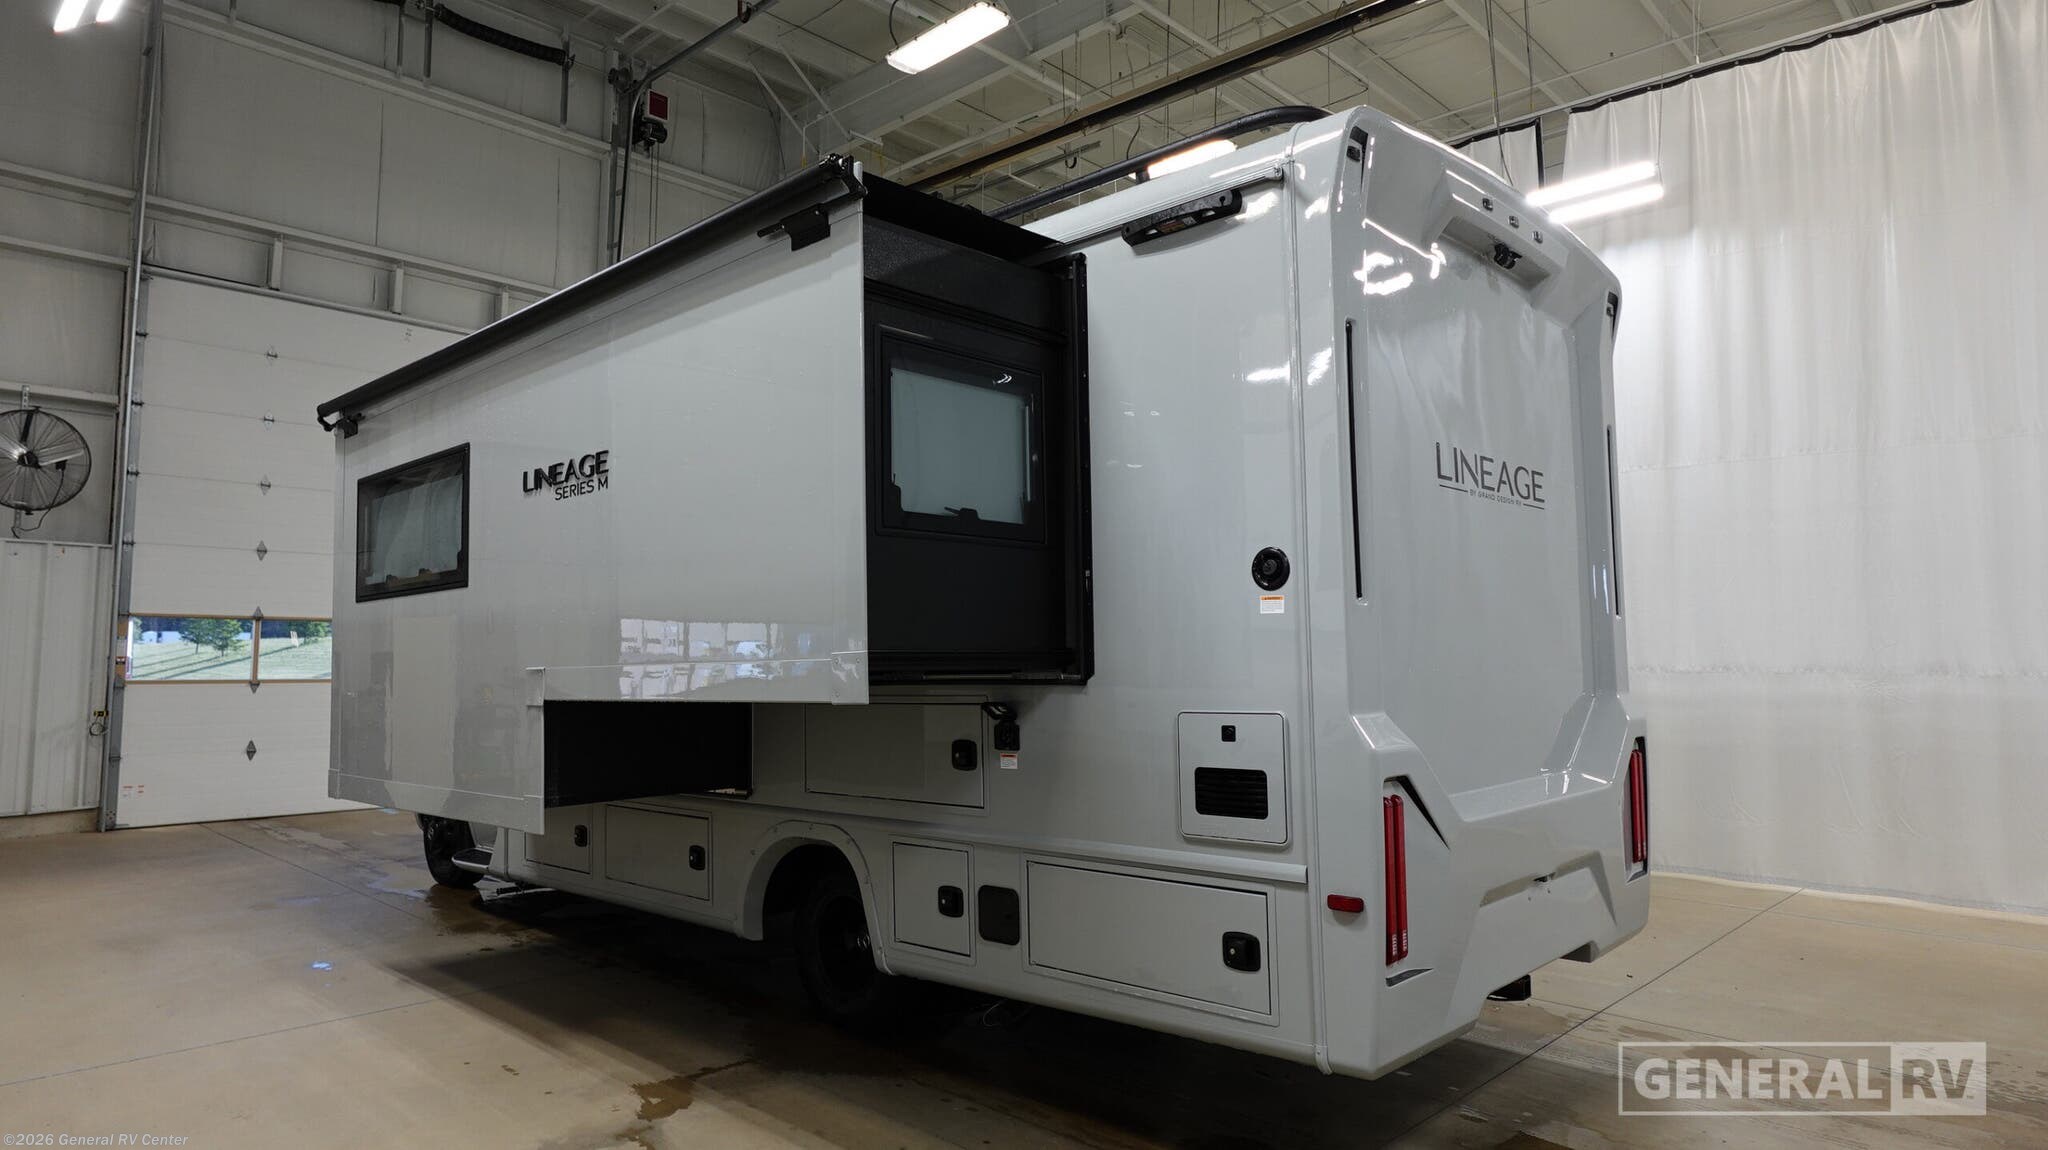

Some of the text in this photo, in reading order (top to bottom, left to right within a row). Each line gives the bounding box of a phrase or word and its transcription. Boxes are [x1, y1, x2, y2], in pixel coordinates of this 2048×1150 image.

[523, 450, 609, 493] LINEAGE
[555, 476, 609, 500] SERIES M
[1436, 442, 1545, 503] LINEAGE
